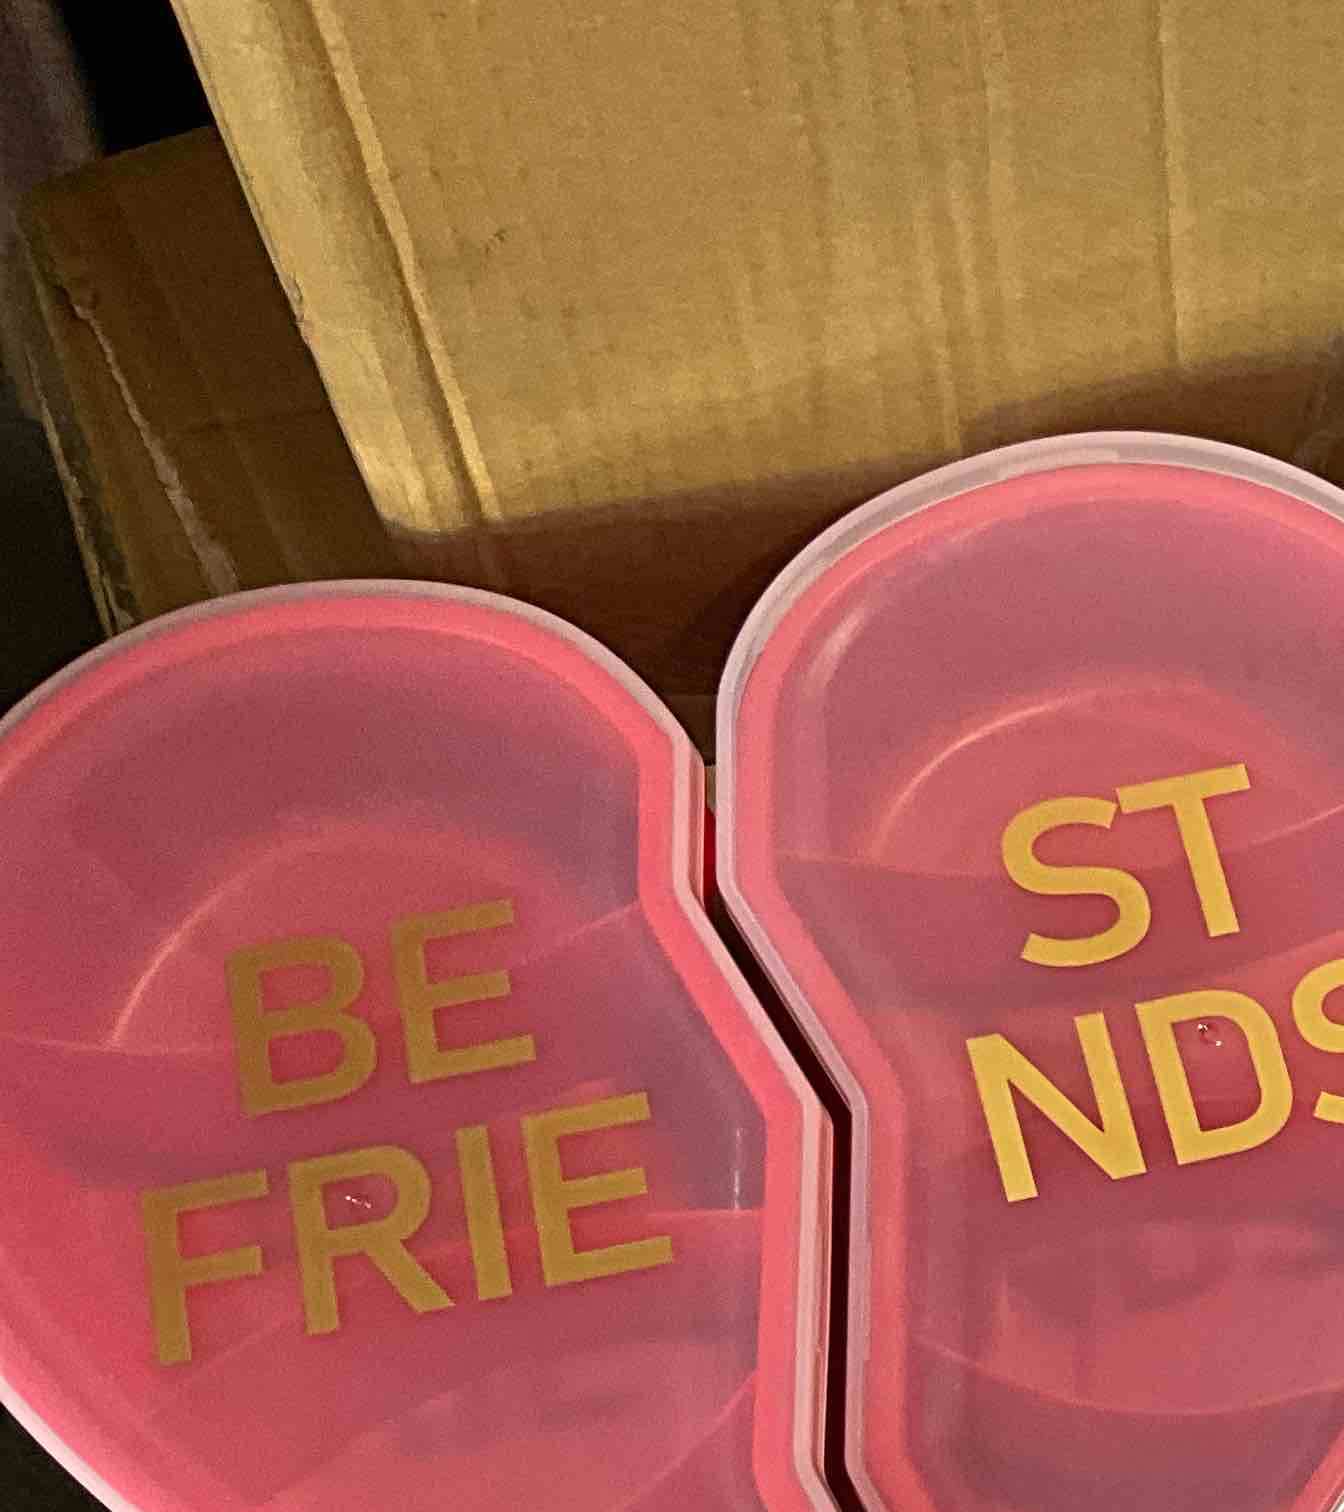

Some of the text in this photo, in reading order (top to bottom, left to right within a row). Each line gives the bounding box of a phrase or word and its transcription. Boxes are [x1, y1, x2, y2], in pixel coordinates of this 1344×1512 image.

[1000, 762, 1251, 968] ST
[225, 899, 538, 1118] BE
[142, 1091, 674, 1366] FRIE
